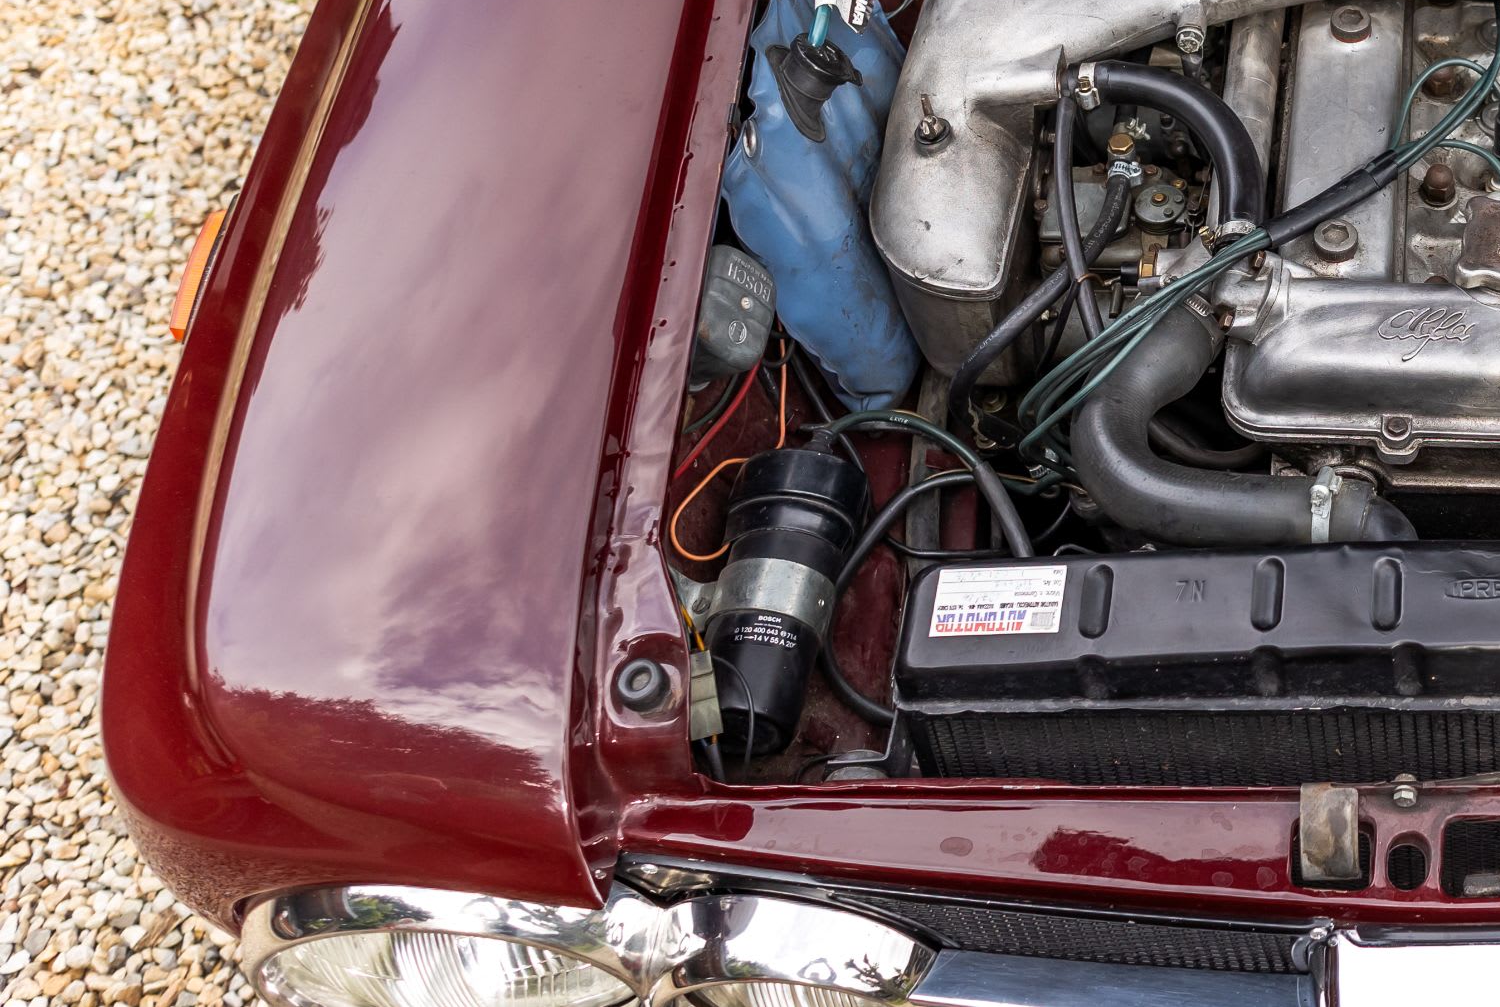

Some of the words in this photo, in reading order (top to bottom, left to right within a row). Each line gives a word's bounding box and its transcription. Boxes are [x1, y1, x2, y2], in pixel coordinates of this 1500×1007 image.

[728, 262, 771, 302] BOSCH
[1377, 307, 1477, 362] Alfa
[758, 615, 781, 623] BOSCH
[935, 609, 1027, 633] AUTOMOTOR
